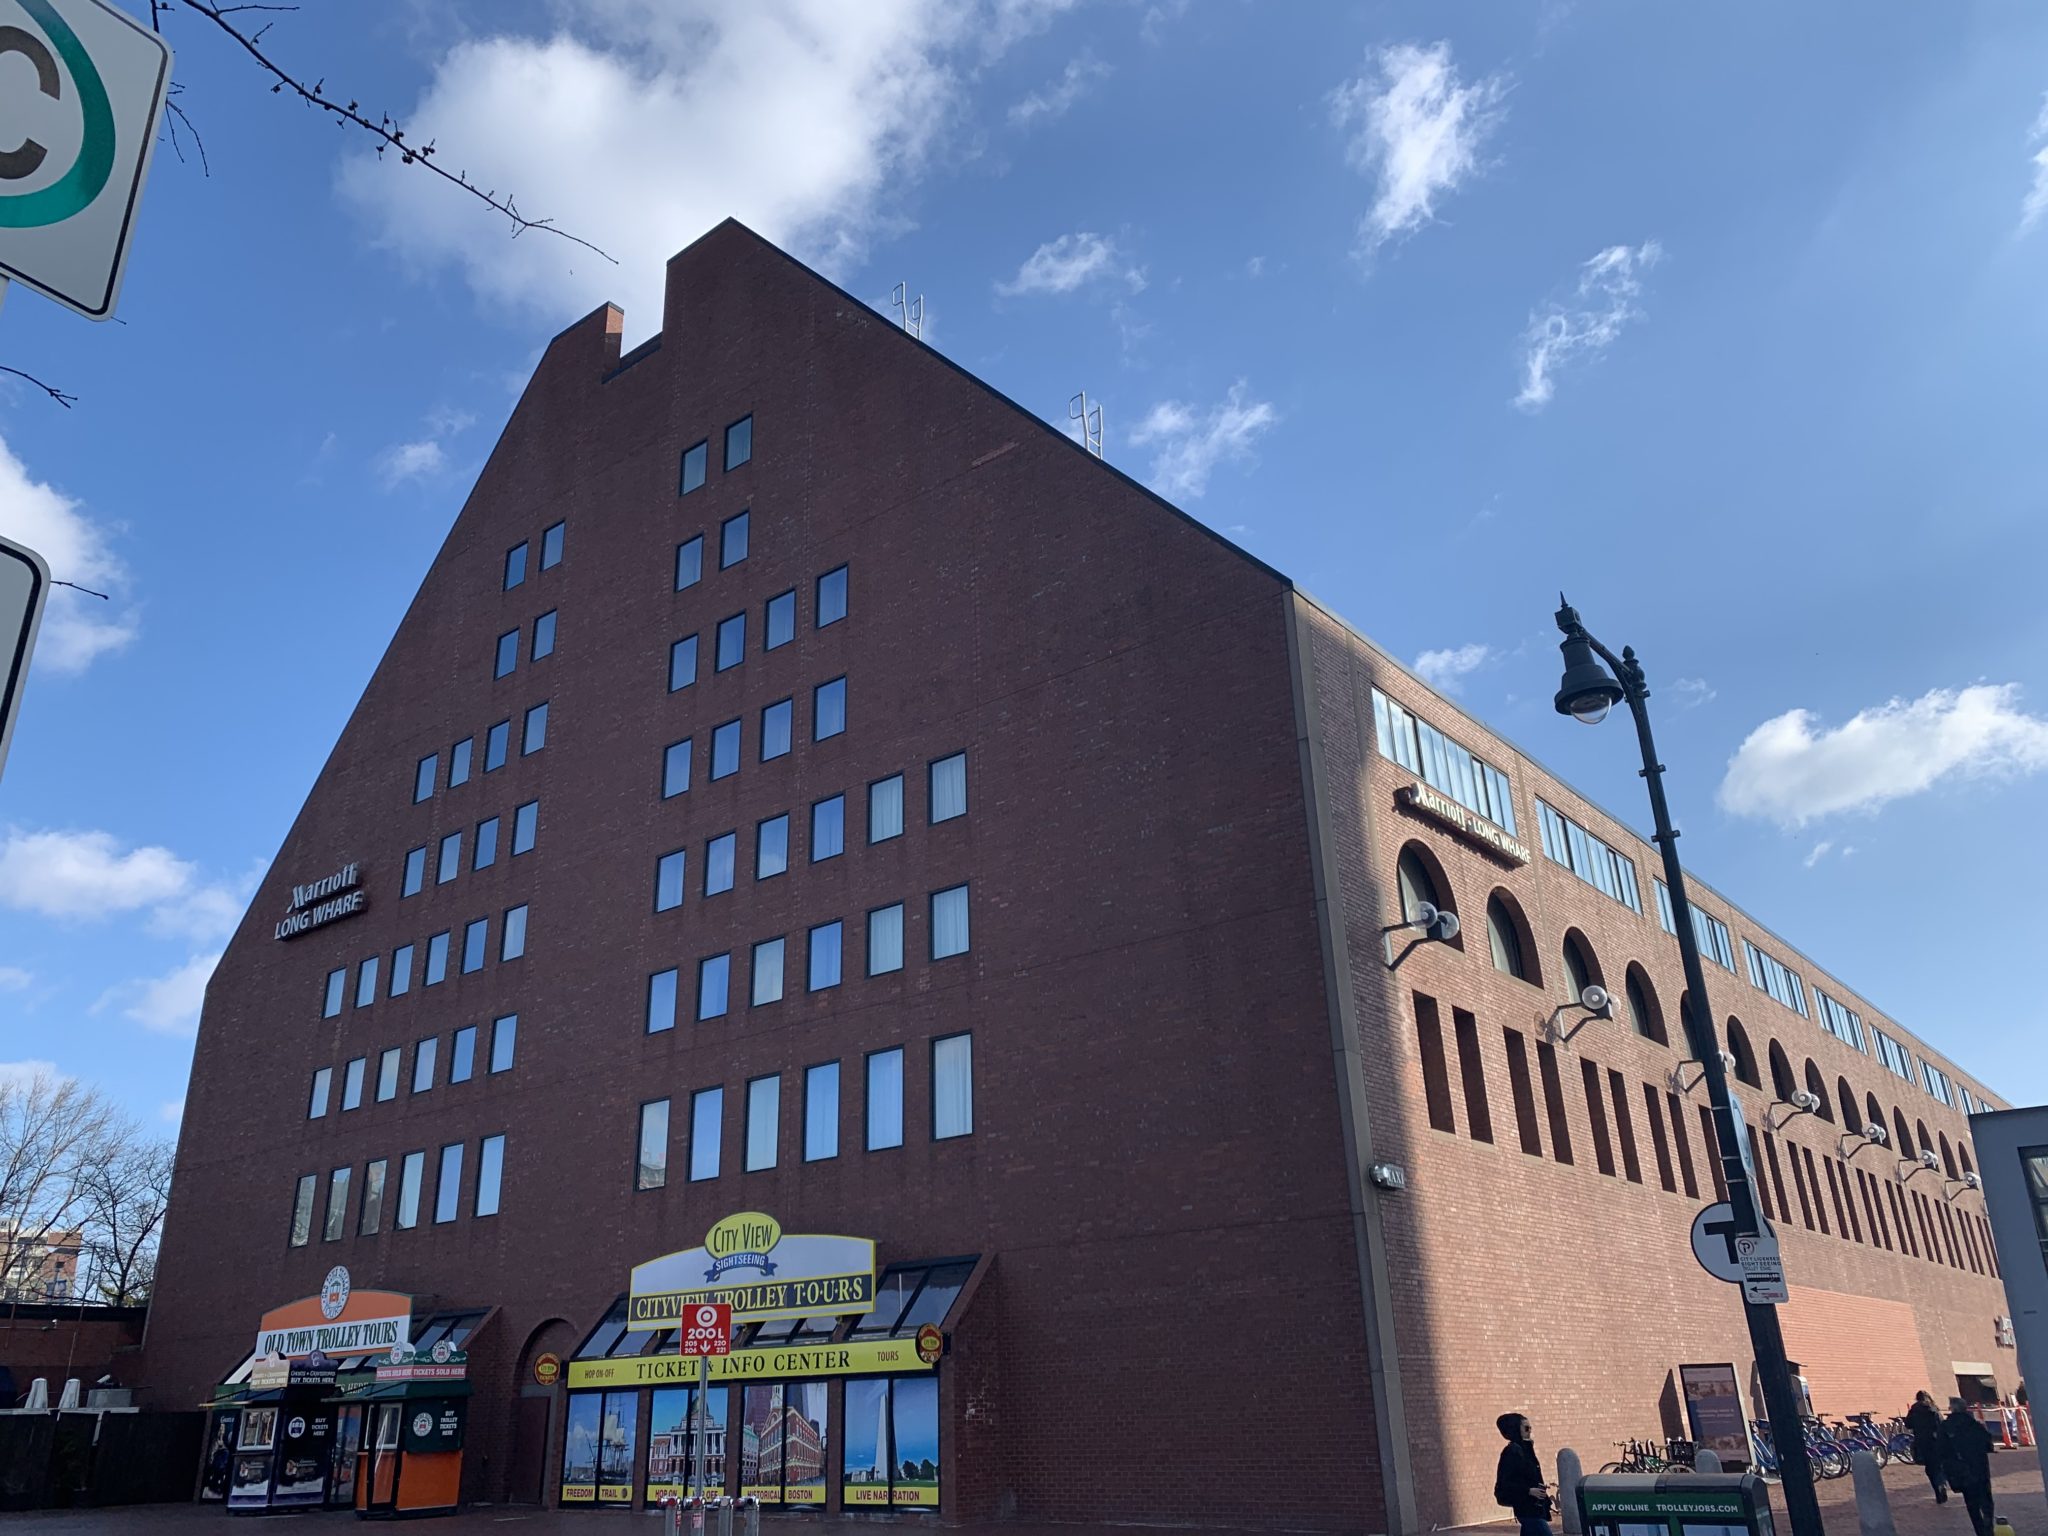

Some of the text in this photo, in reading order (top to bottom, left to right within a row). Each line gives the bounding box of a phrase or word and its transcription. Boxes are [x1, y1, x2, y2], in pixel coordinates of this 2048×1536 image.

[1409, 782, 1531, 864] Marriott LONG WHARF
[286, 862, 358, 913] Marriott
[274, 890, 363, 939] LONG WHARF
[713, 1223, 773, 1252] CITY VIEW
[715, 1254, 766, 1271] SIGHTSEEING
[714, 1285, 788, 1312] TROLLEY
[265, 1320, 398, 1355] OLD TOWN TROLLEY TOURS
[637, 1360, 699, 1379] TICKET
[722, 1355, 765, 1374] INFO
[773, 1350, 850, 1371] CENTER
[877, 1351, 899, 1362] TOURS
[413, 1368, 435, 1376] TICKETS
[584, 1370, 595, 1379] HOP
[566, 1488, 618, 1498] FREEDOM TRAIL
[747, 1489, 813, 1500] HISTORICAL BOSTON
[856, 1489, 872, 1500] LIVE
[1592, 1503, 1738, 1513] APPLY ONLINE TROLLEYJOBS.COM
